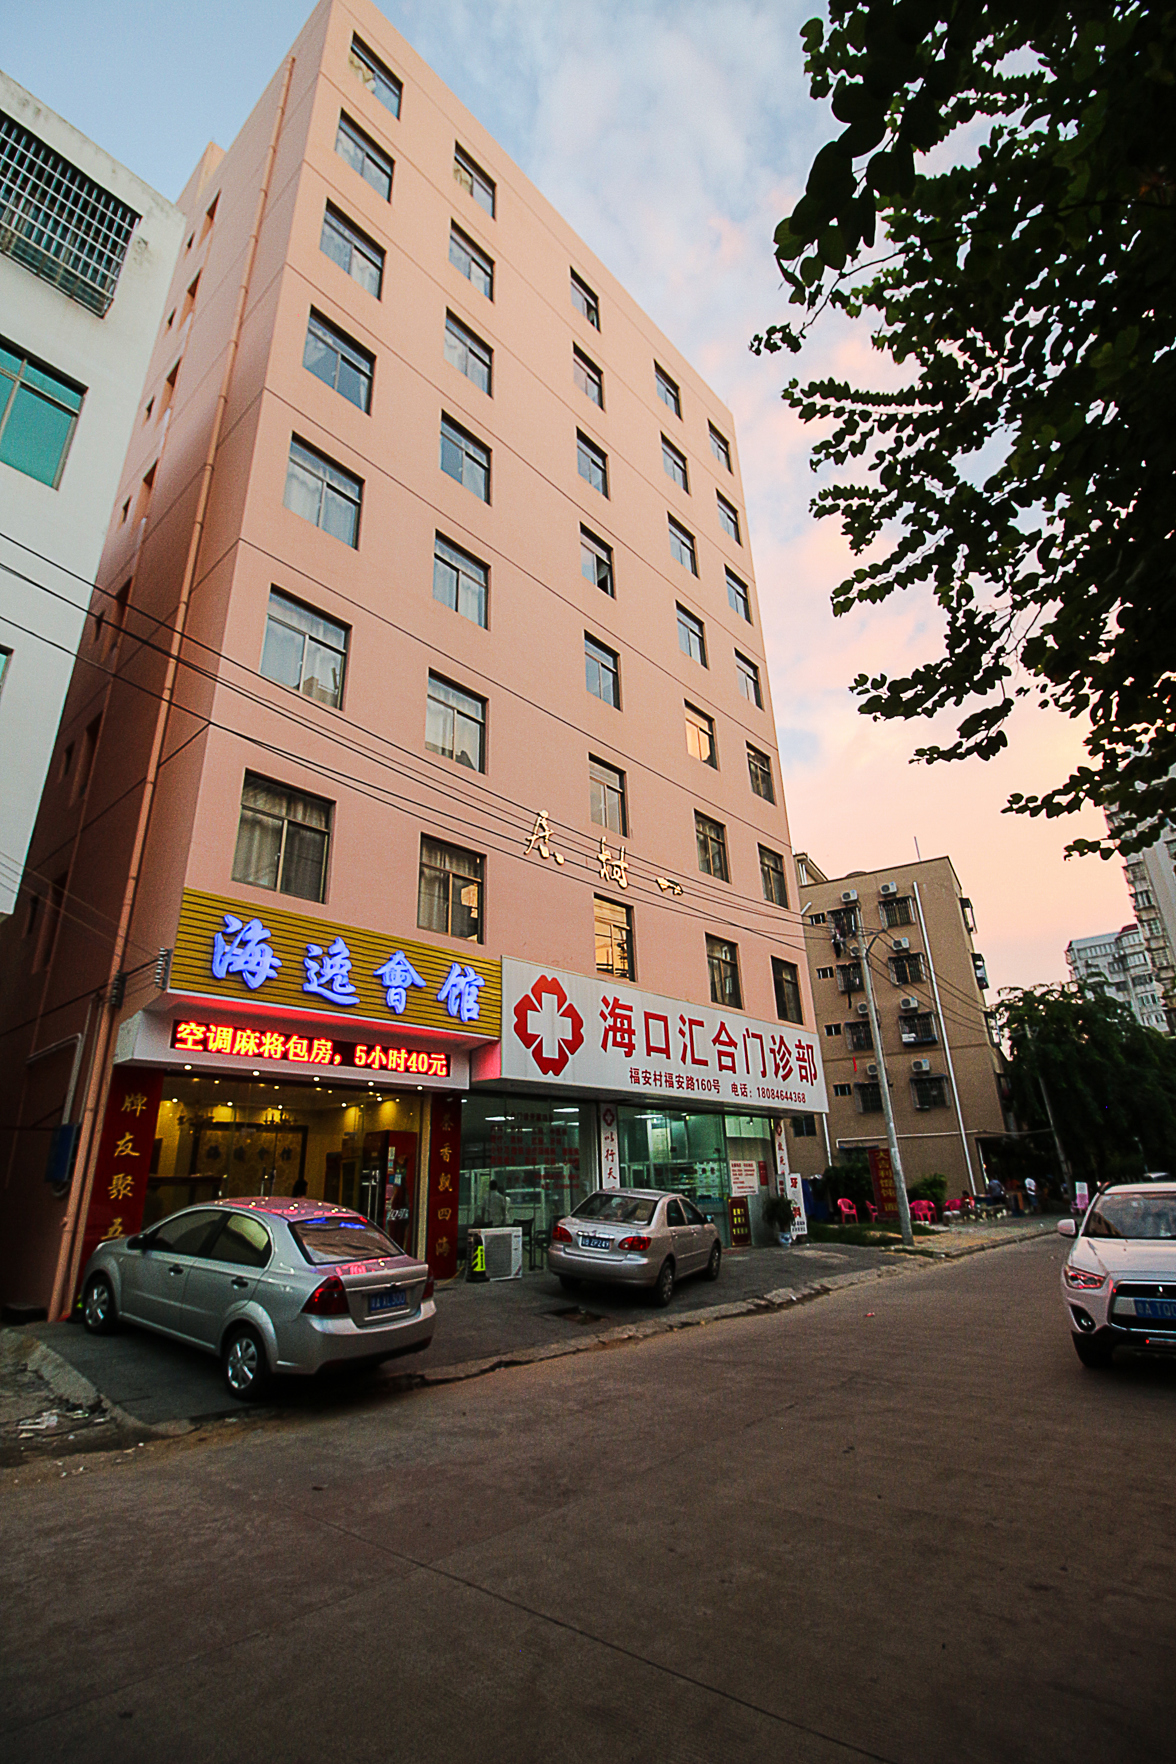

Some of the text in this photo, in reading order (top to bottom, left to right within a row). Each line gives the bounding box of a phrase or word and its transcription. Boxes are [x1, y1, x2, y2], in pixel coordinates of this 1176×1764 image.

[599, 996, 819, 1087] 海口汇合门诊部
[629, 1067, 721, 1094] 福安村福安路160号
